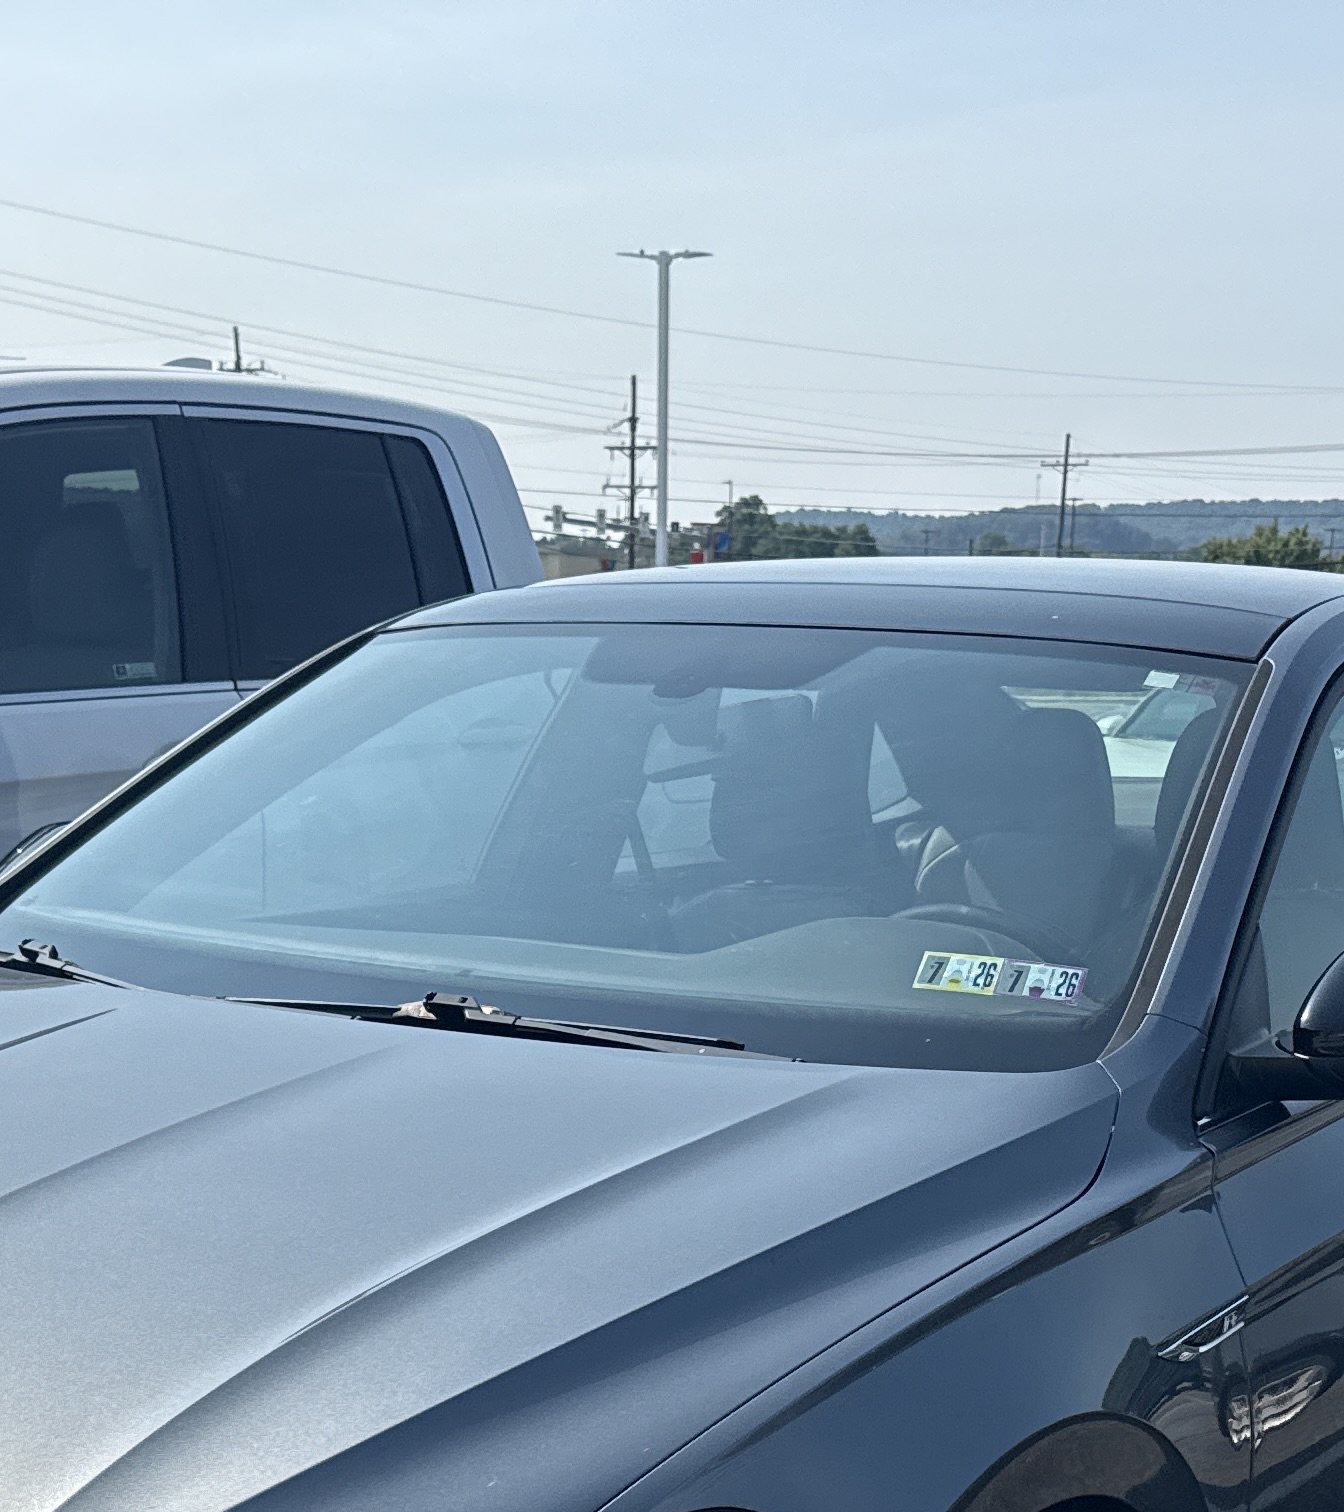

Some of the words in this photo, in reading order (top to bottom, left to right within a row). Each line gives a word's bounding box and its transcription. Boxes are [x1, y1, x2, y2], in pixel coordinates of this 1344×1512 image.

[928, 961, 943, 984] 7
[972, 961, 998, 988] 26
[1007, 969, 1024, 993] 7
[1055, 970, 1080, 998] 26
